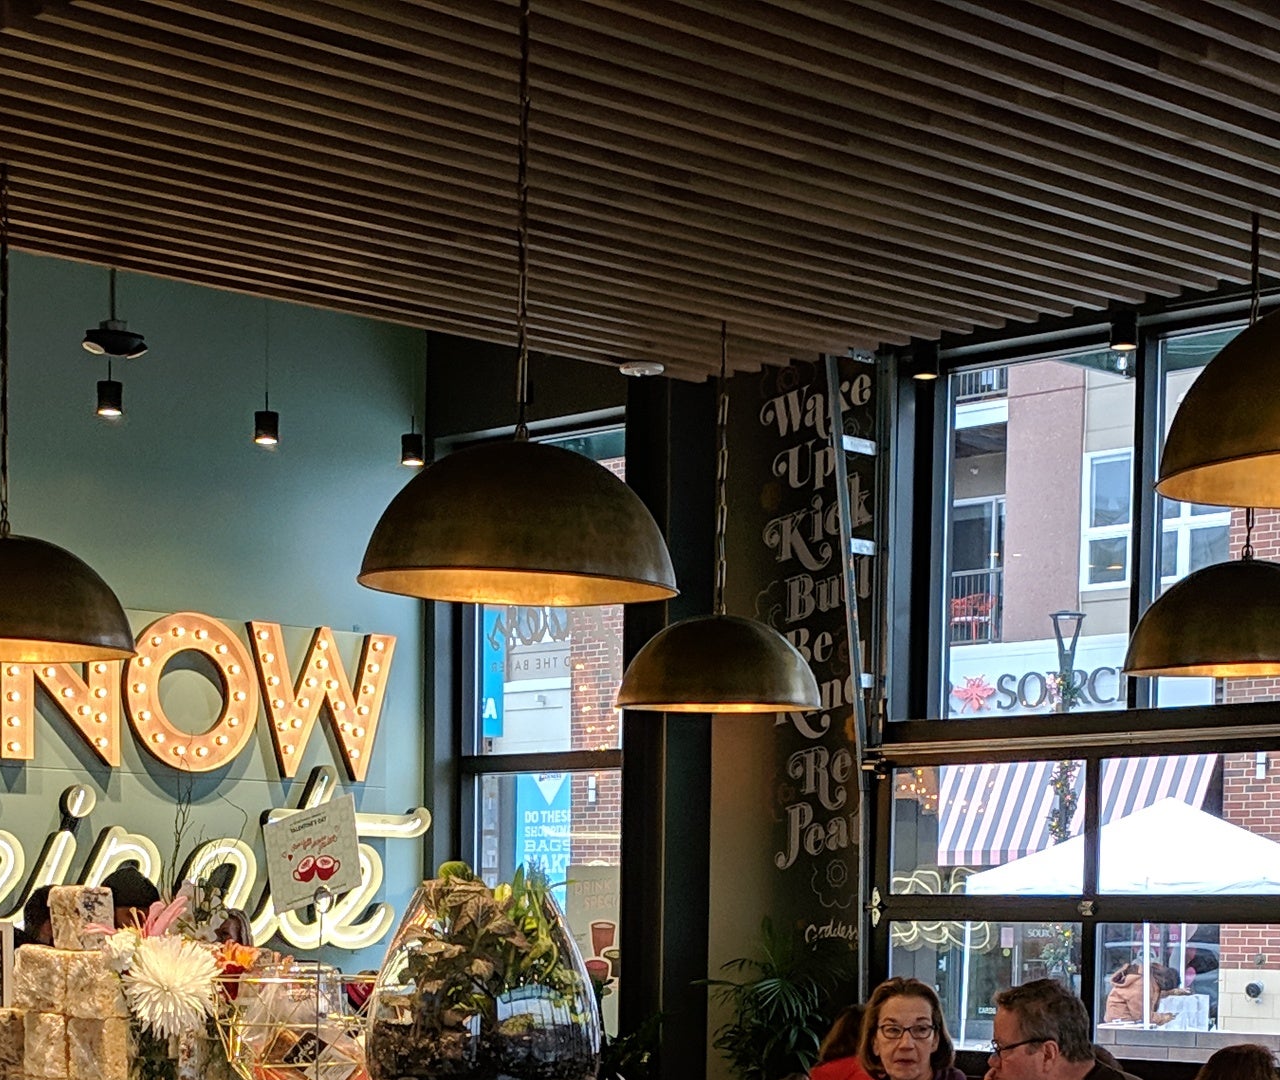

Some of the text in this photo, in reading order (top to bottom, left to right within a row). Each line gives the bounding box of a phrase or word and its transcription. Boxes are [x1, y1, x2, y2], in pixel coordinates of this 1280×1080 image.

[772, 439, 837, 490] Up
[784, 557, 871, 623] But
[788, 746, 852, 811] Re
[525, 811, 539, 823] DO
[524, 854, 571, 873] MAK
[583, 894, 618, 910] SPECI
